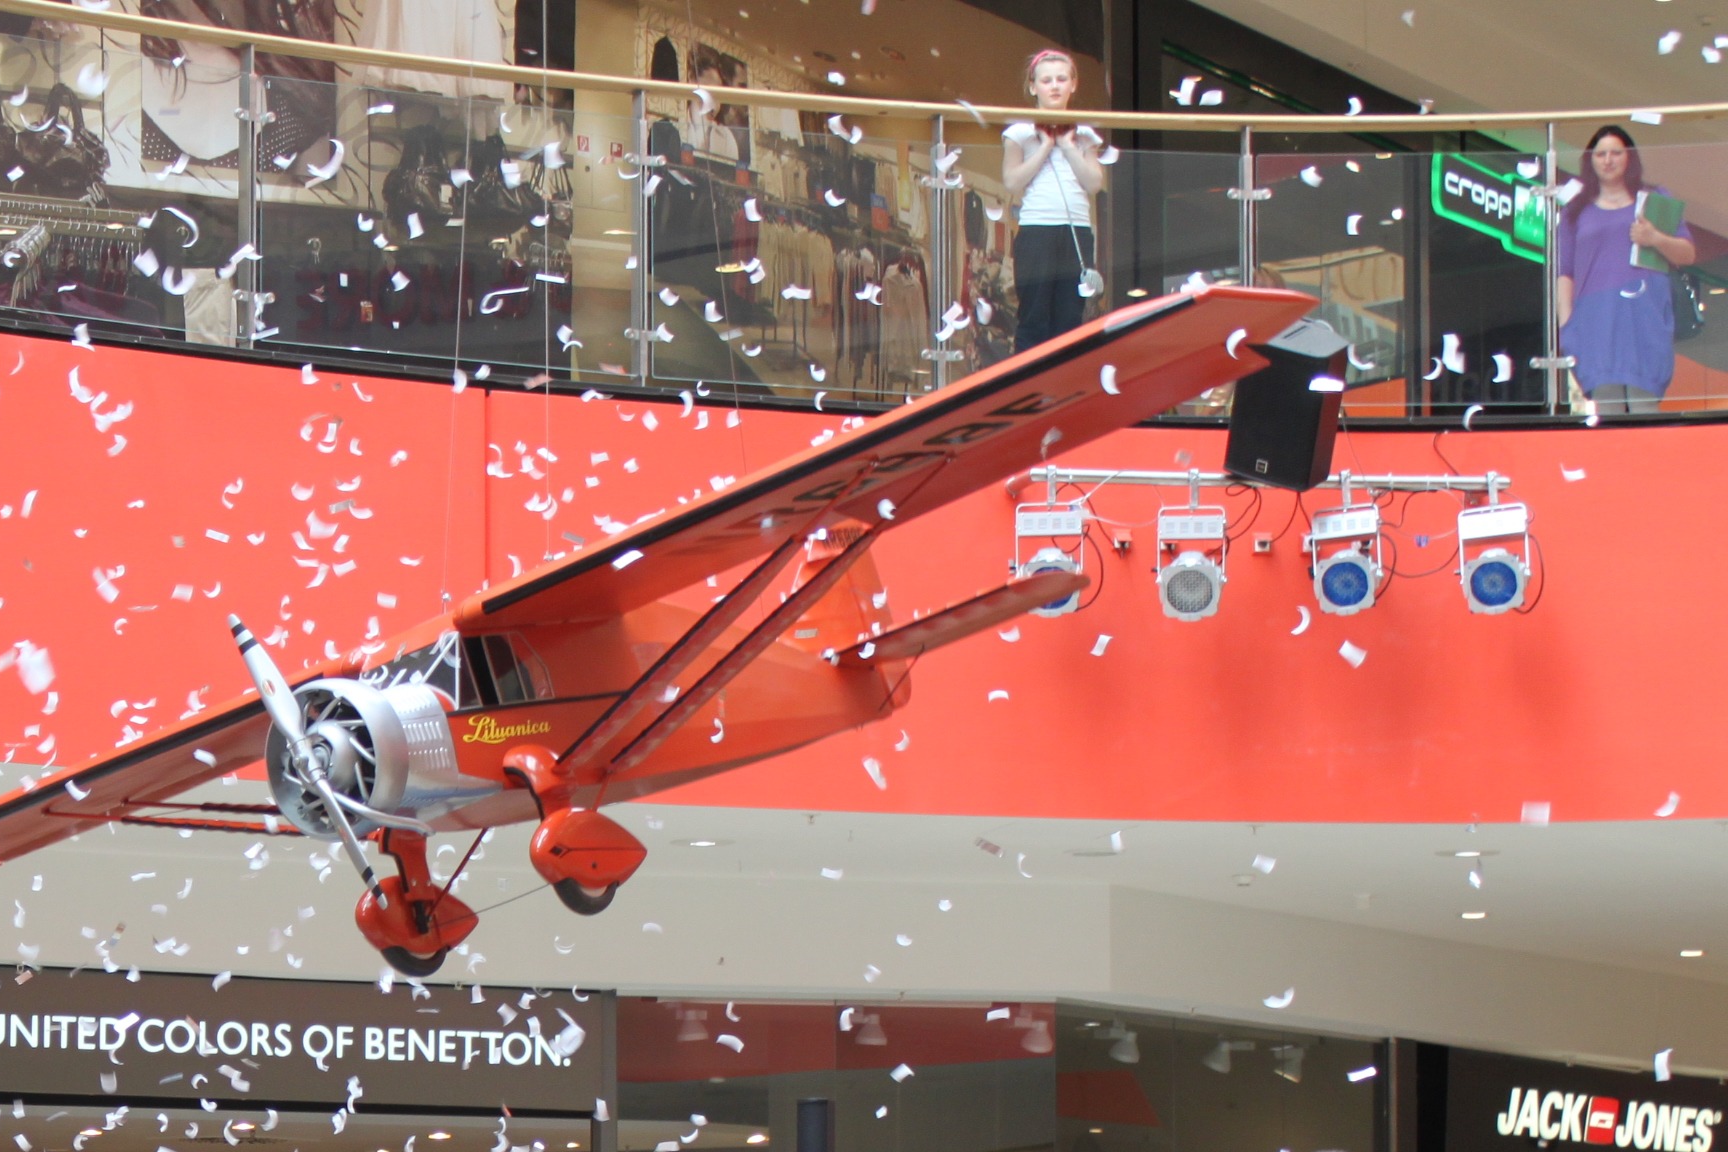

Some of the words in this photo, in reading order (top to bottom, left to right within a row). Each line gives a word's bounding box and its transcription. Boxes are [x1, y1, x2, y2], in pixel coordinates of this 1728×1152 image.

[1444, 170, 1513, 220] cropp
[462, 713, 552, 745] Lituanica
[137, 1017, 293, 1057] COLORS
[302, 1024, 355, 1059] OF
[1497, 1087, 1588, 1143] JACK
